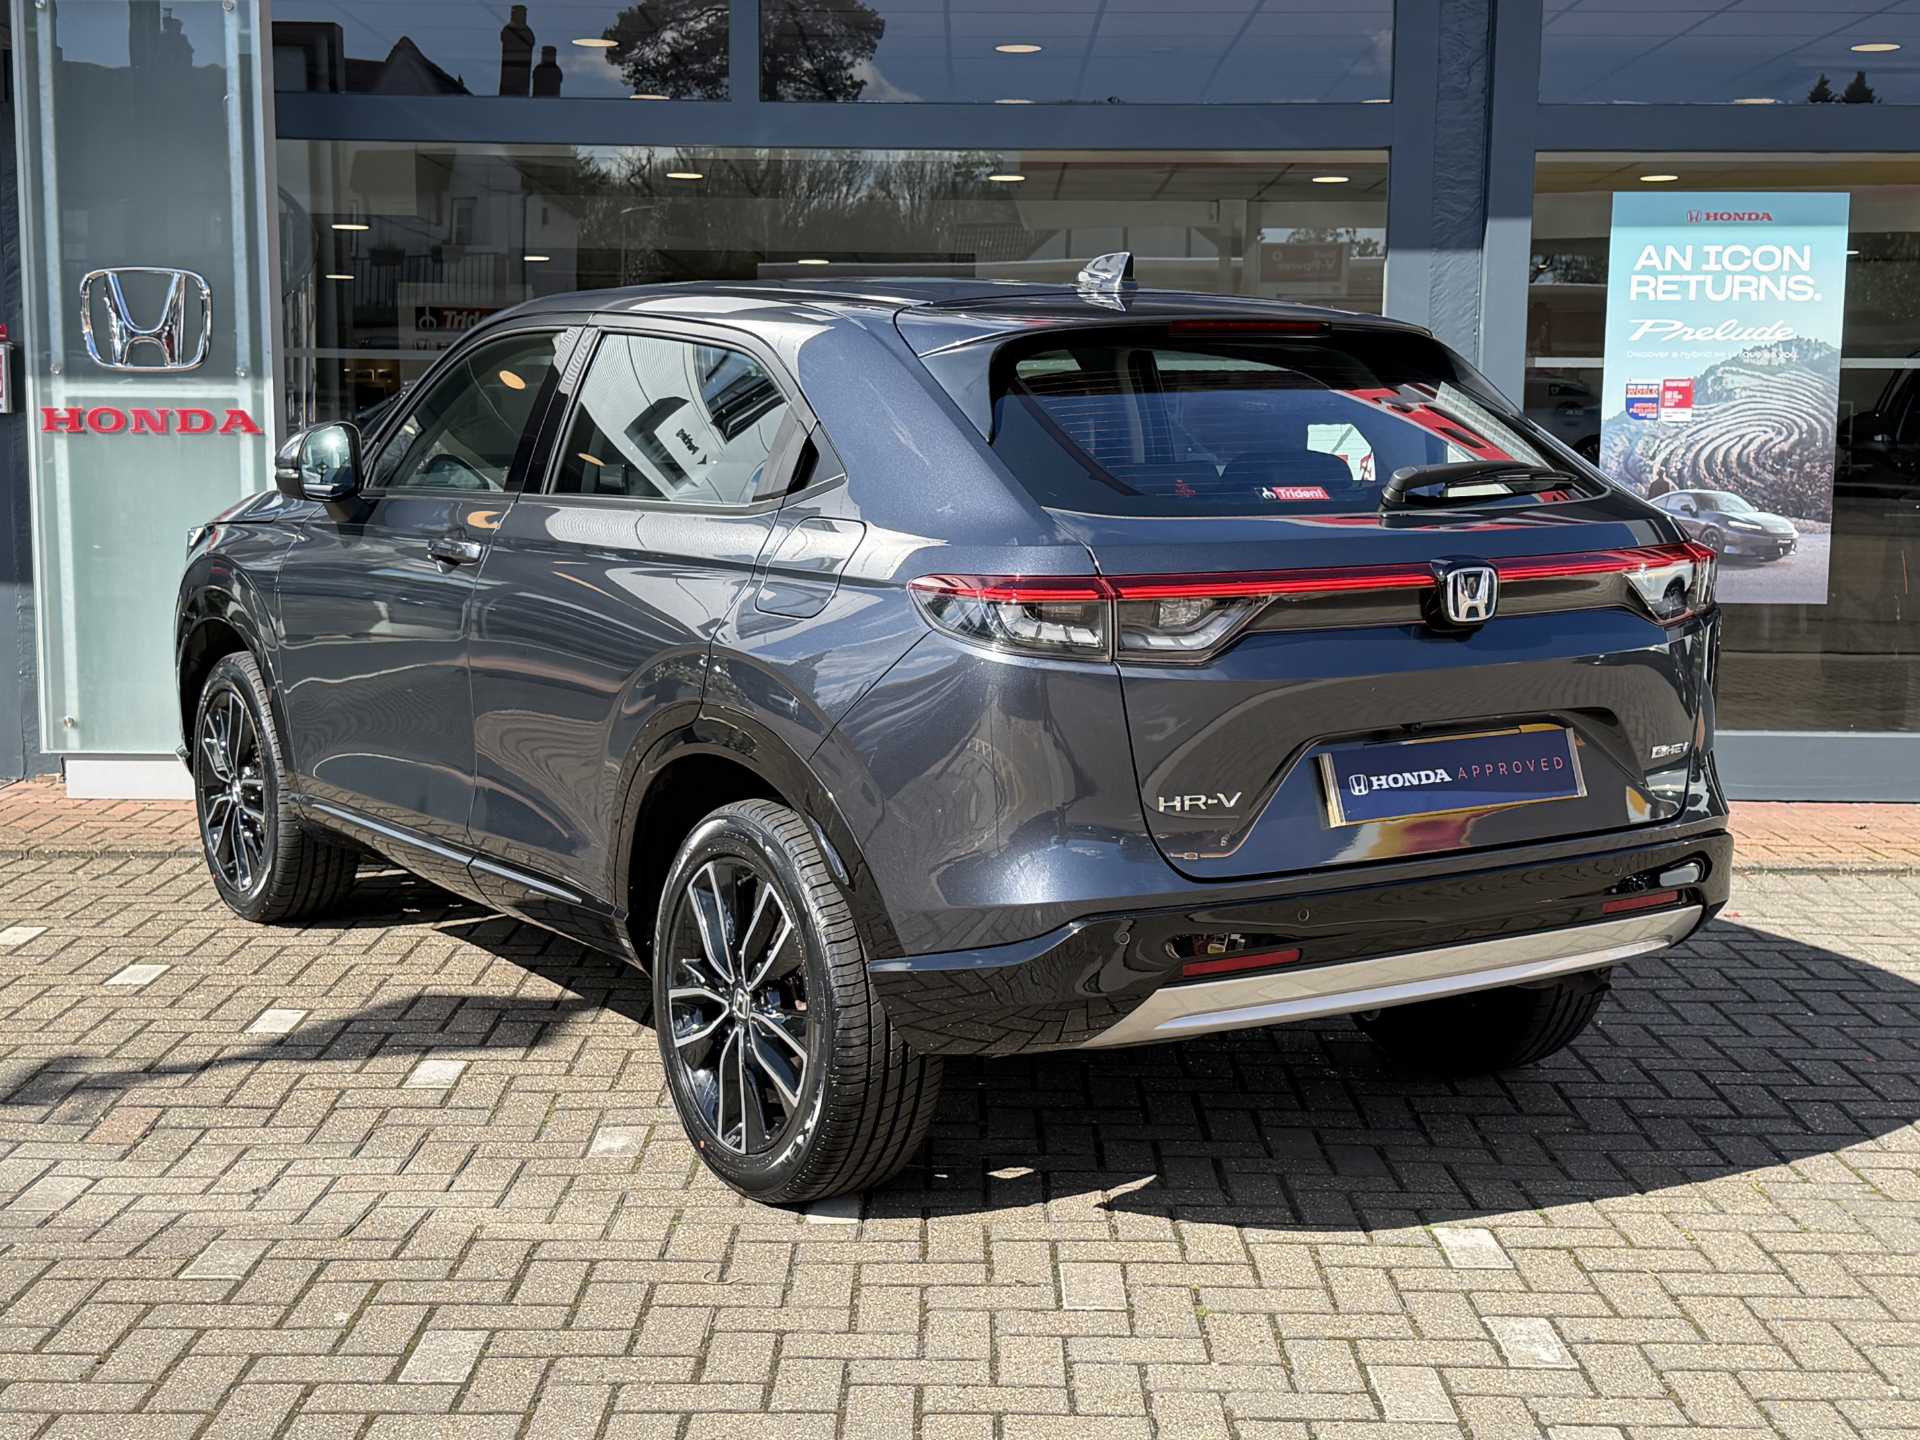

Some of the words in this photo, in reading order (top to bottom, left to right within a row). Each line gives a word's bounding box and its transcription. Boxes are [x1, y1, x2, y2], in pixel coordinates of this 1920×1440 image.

[1704, 211, 1773, 222] HONDA
[1633, 244, 1693, 272] AN
[1701, 244, 1811, 272] ICON
[1629, 273, 1823, 302] RETURNS.
[1628, 318, 1798, 342] Prelude
[40, 407, 265, 435] HONDA
[1279, 488, 1324, 498] Trident
[1369, 768, 1453, 791] HONDA
[1457, 755, 1564, 780] APPROVED
[1158, 791, 1243, 813] HR-V
